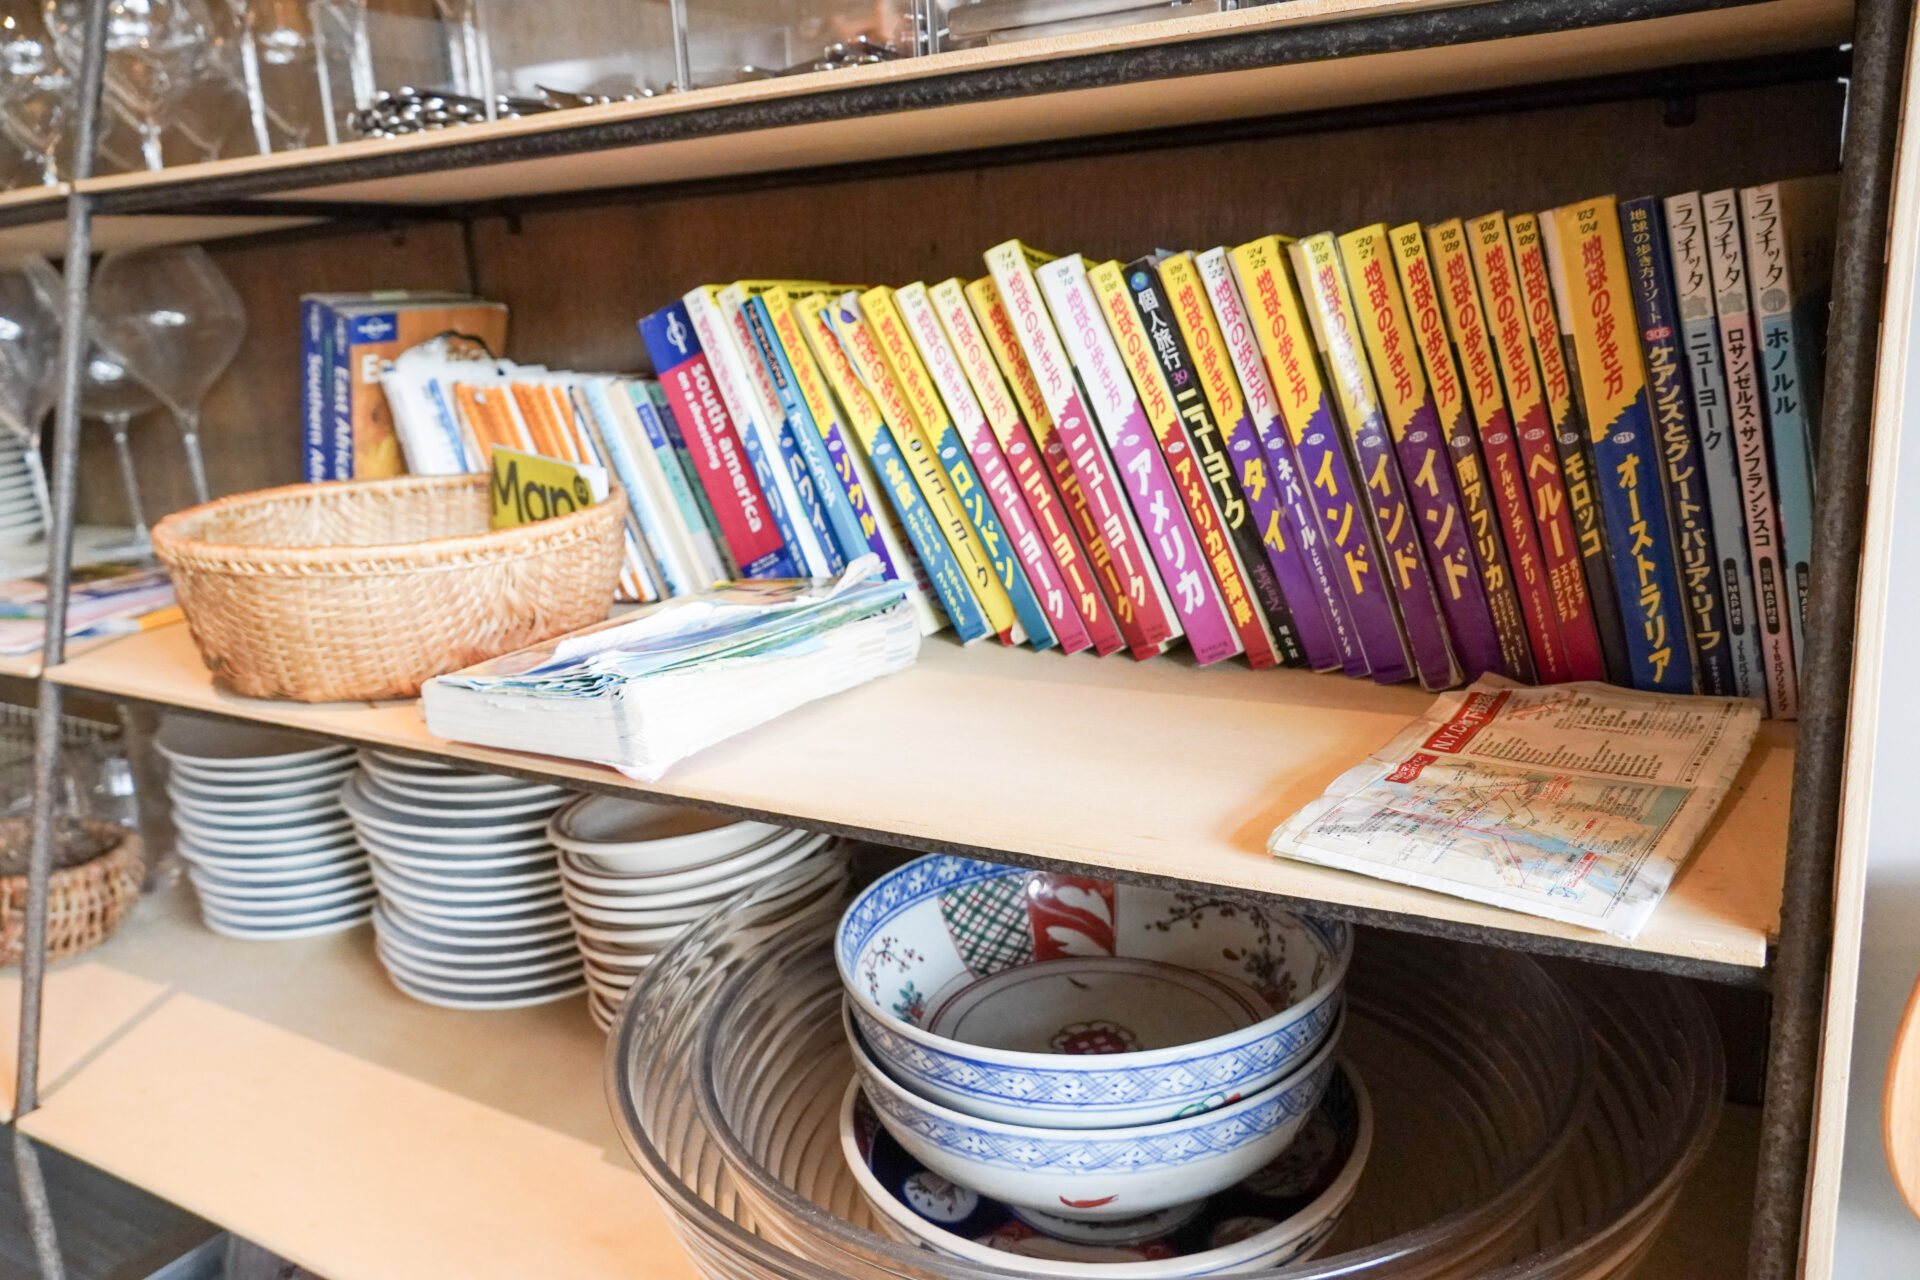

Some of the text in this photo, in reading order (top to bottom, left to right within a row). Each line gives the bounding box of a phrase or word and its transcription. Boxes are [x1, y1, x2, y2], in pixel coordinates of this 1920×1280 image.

[1137, 287, 1183, 372] 個人旅行
[1364, 259, 1414, 405] 地球の歩き方
[1447, 252, 1494, 405] 地球の歩き方
[1486, 244, 1531, 399] 地球の歩き方
[1522, 246, 1567, 402] 地球の歩き方
[1582, 234, 1623, 400] 地球の歩き方
[1630, 208, 1662, 324] 地球の歩き方リゾート
[852, 322, 914, 440] 地球の歩き方
[880, 316, 938, 428] 地球の歩き方
[917, 309, 974, 423] 地球の歩き方
[951, 306, 1007, 423] 地球の歩き方
[989, 302, 1045, 422] 地球の歩き方
[1008, 271, 1063, 396] 地球の歩き方
[1066, 287, 1122, 412] 地球の歩き方
[1109, 292, 1167, 420] 地球の歩き方
[1178, 284, 1233, 416] 地球の歩き方
[1215, 278, 1269, 414] 地球の歩き方
[1257, 268, 1309, 409] 地球の歩き方
[1408, 257, 1457, 408] 地球の歩き方
[1691, 332, 1722, 450] ニューヨーク
[1767, 328, 1797, 415] ホノルル
[718, 436, 762, 533] america
[835, 453, 876, 539] ソウル
[1176, 388, 1246, 530] ニューヨーク
[1529, 443, 1565, 557] ペルー
[1728, 329, 1771, 547] ロサンゼルス・サンフランシスコ
[919, 457, 989, 588] ニューヨーク
[950, 460, 1014, 590] ロンドン
[985, 456, 1064, 620] ニューヨーク
[1019, 457, 1097, 623] ニューヨーク
[1056, 458, 1133, 624] ニューヨーク
[1072, 433, 1146, 607] ニューヨーク
[1127, 448, 1206, 615] アメリカ
[1243, 457, 1287, 553] タイ
[1314, 450, 1369, 595] インド
[1369, 453, 1417, 590] インド
[1414, 448, 1468, 600] インド
[1456, 453, 1504, 591] 南アフリカ
[1496, 452, 1527, 549] アルゼンチン
[1520, 552, 1536, 584] チリ
[1565, 452, 1601, 557] モロッコ
[1616, 453, 1671, 684] オーストラリア
